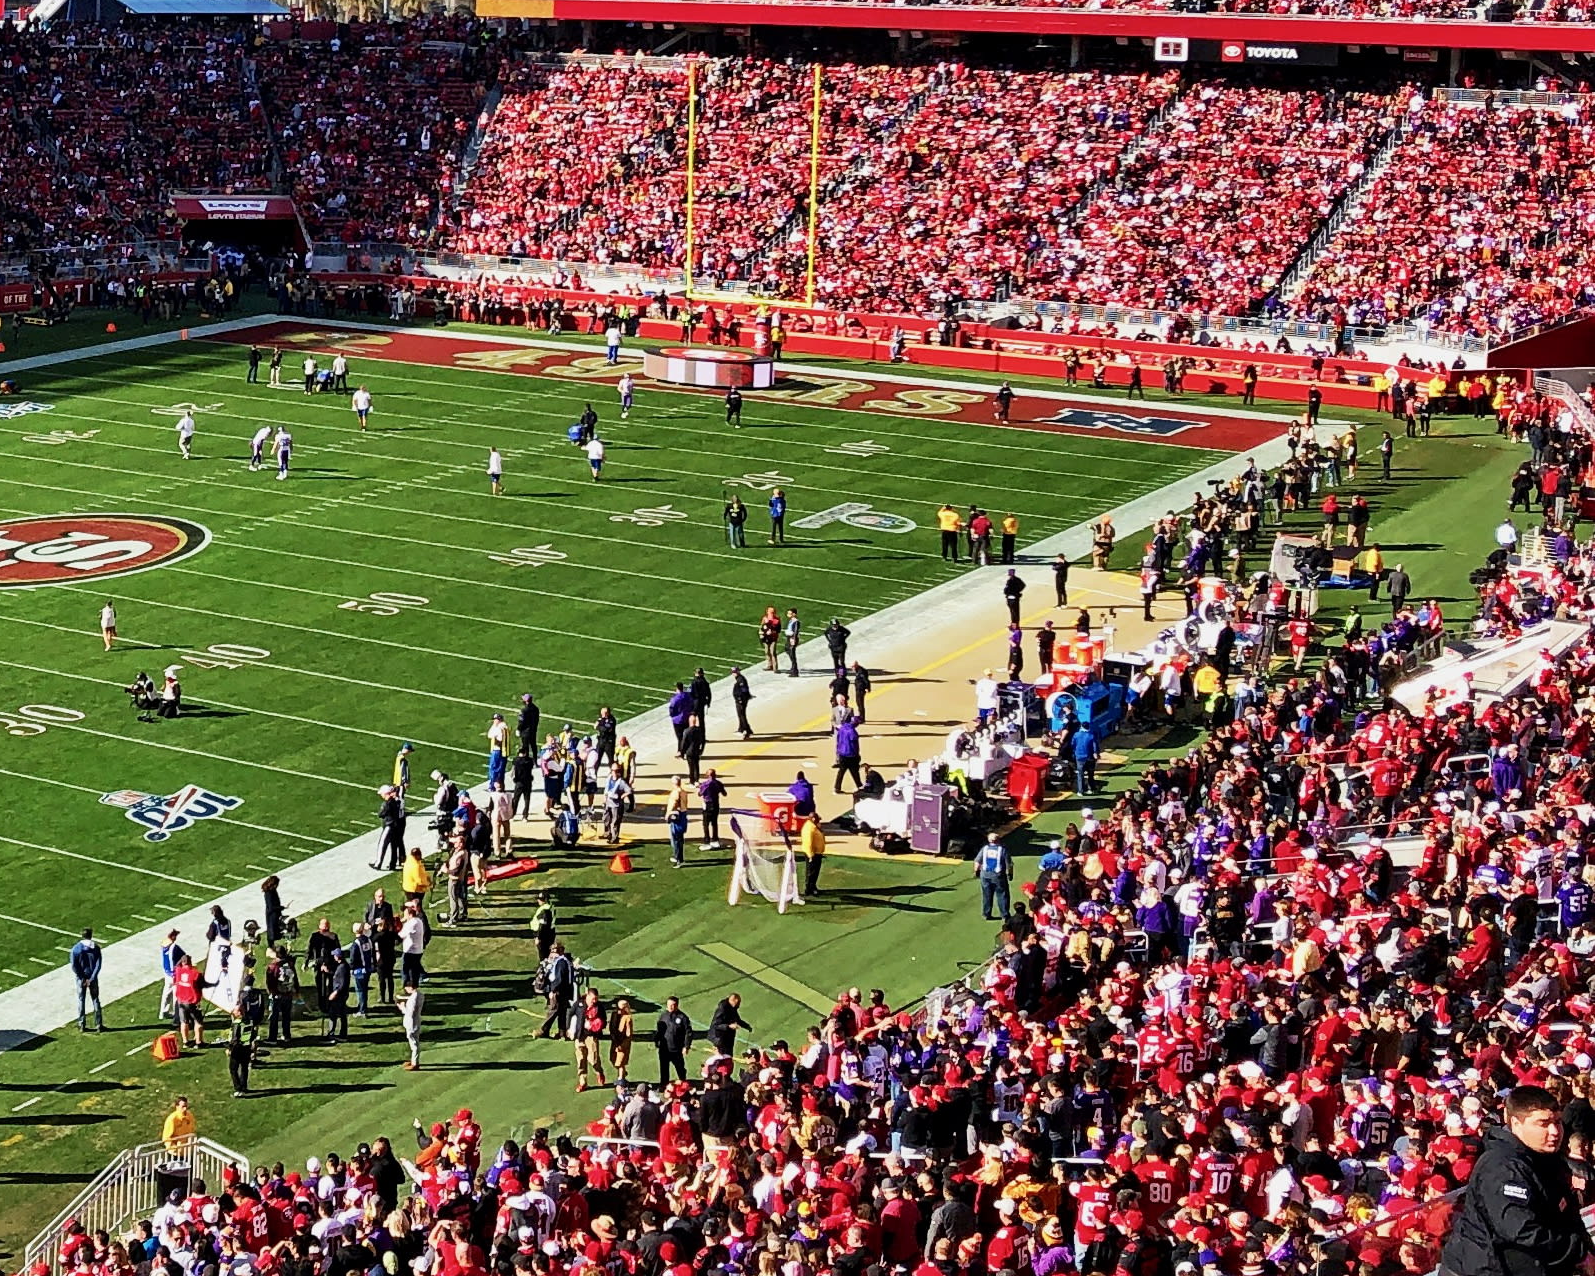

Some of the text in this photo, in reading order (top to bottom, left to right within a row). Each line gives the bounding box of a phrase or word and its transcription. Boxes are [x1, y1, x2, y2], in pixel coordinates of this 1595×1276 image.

[1246, 47, 1298, 59] TOYOTA
[180, 643, 271, 670] 40
[1176, 1052, 1194, 1074] 16
[1149, 1182, 1172, 1204] 80
[1209, 1171, 1232, 1194] 10
[252, 1213, 268, 1238] 82
